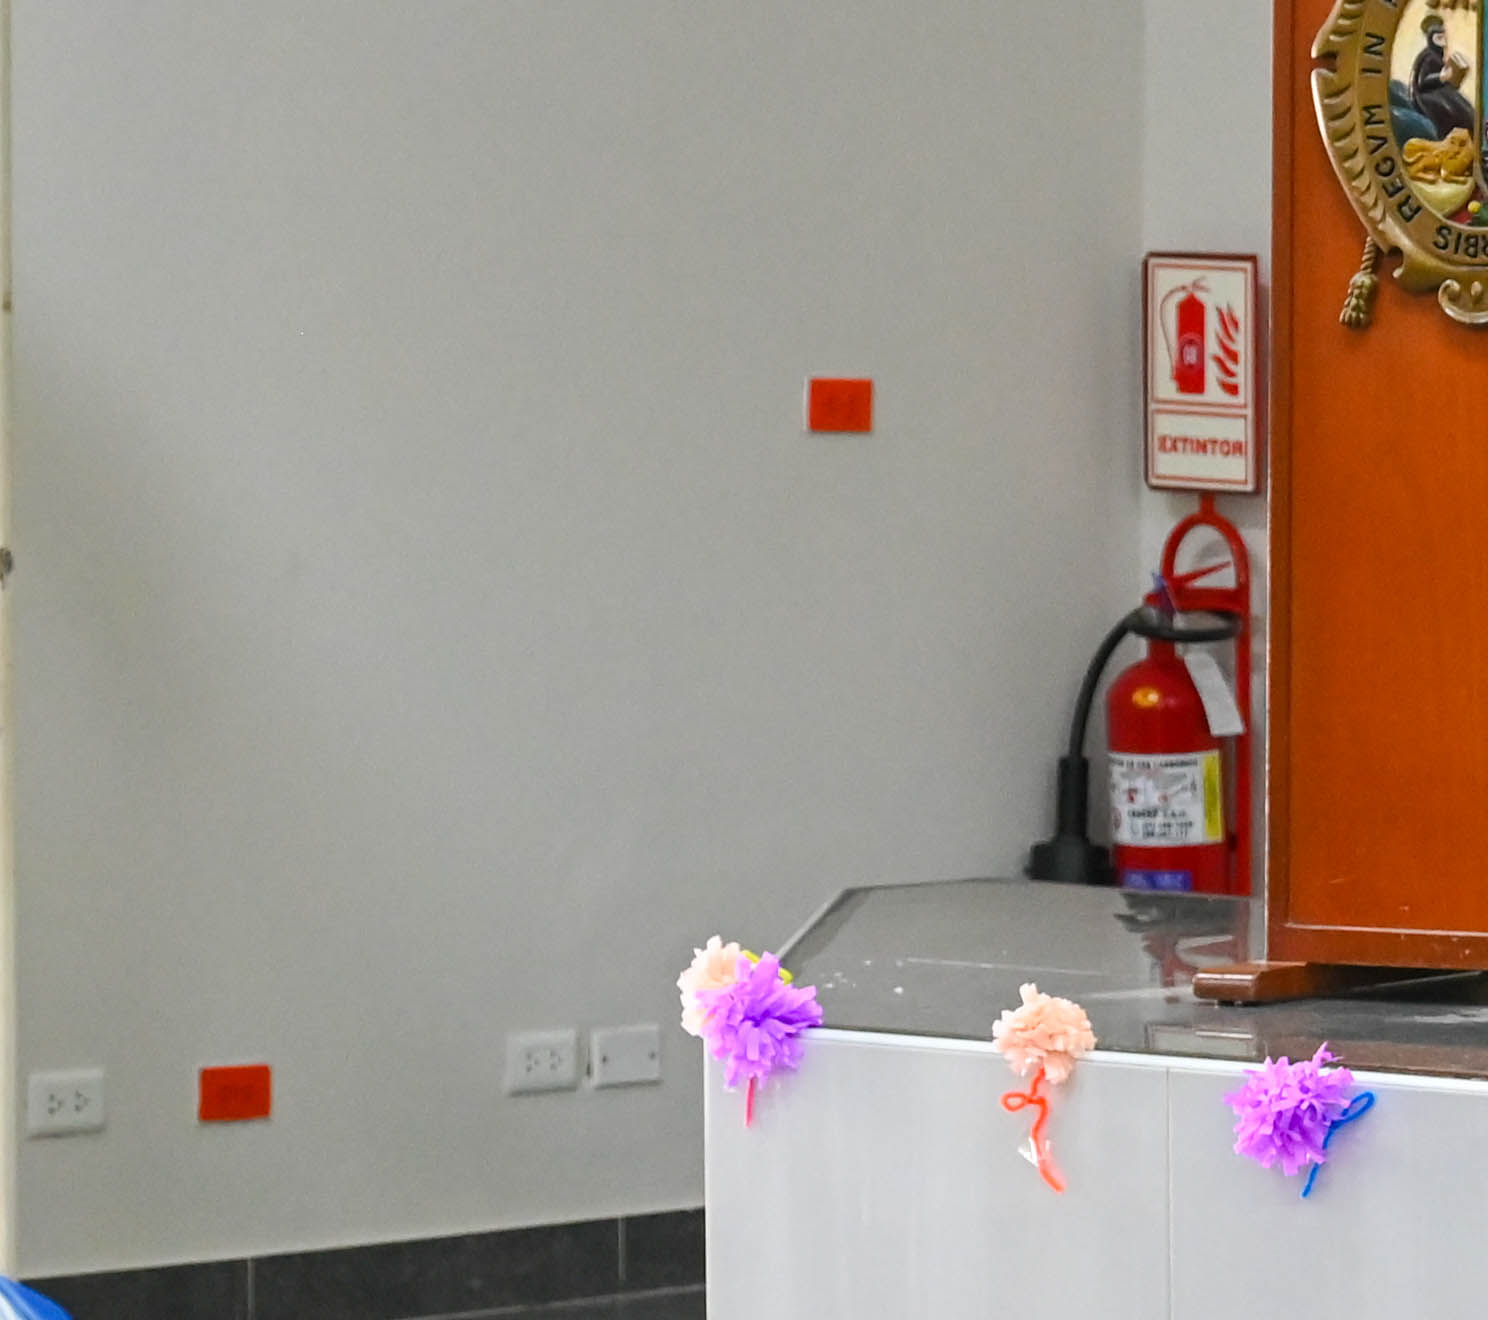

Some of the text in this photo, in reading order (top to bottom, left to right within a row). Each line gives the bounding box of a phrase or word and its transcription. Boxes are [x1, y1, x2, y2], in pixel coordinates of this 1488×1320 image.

[1362, 32, 1387, 76] IN
[1362, 103, 1423, 224] REGVM
[1158, 435, 1243, 456] EXTINTOR
